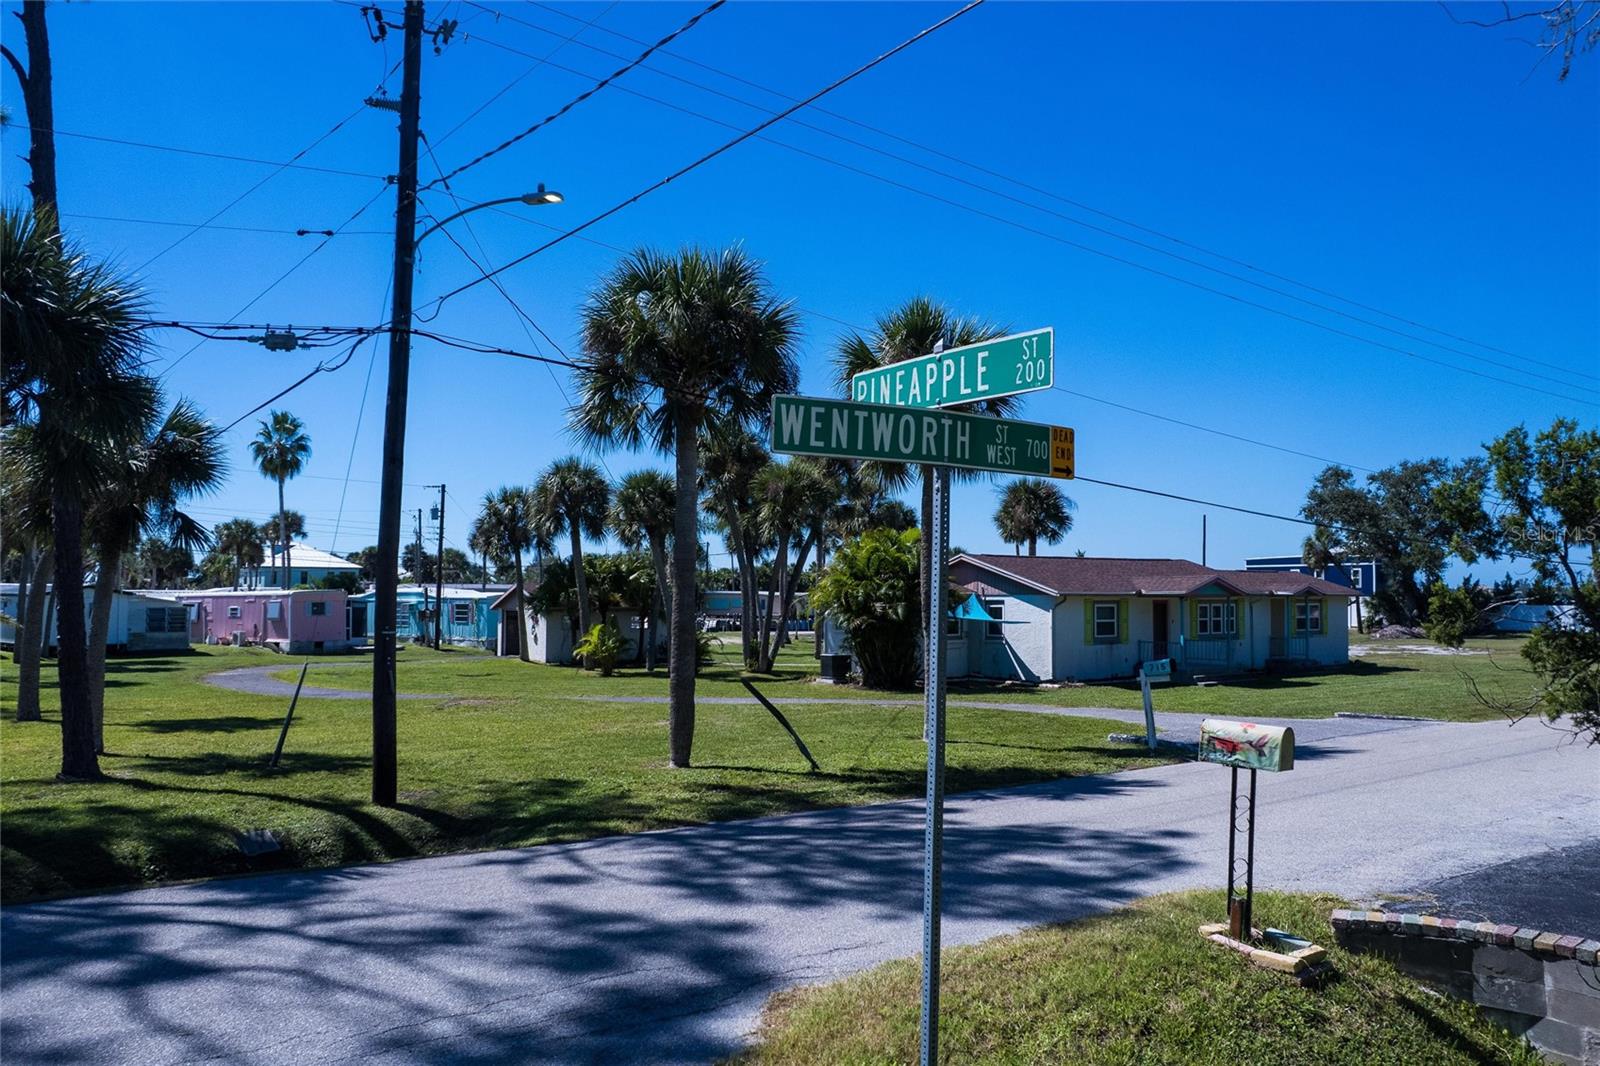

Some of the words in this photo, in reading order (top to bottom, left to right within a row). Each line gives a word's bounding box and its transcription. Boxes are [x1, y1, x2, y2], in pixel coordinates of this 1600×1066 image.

[1022, 337, 1038, 360] ST
[858, 351, 989, 405] PINEAPPLE
[1016, 359, 1045, 384] 200
[780, 403, 970, 460] WENTWORTH
[995, 424, 1008, 444] ST
[1053, 428, 1073, 444] DEAD
[987, 444, 1016, 466] WEST
[1026, 439, 1048, 459] 700
[1056, 446, 1071, 460] END
